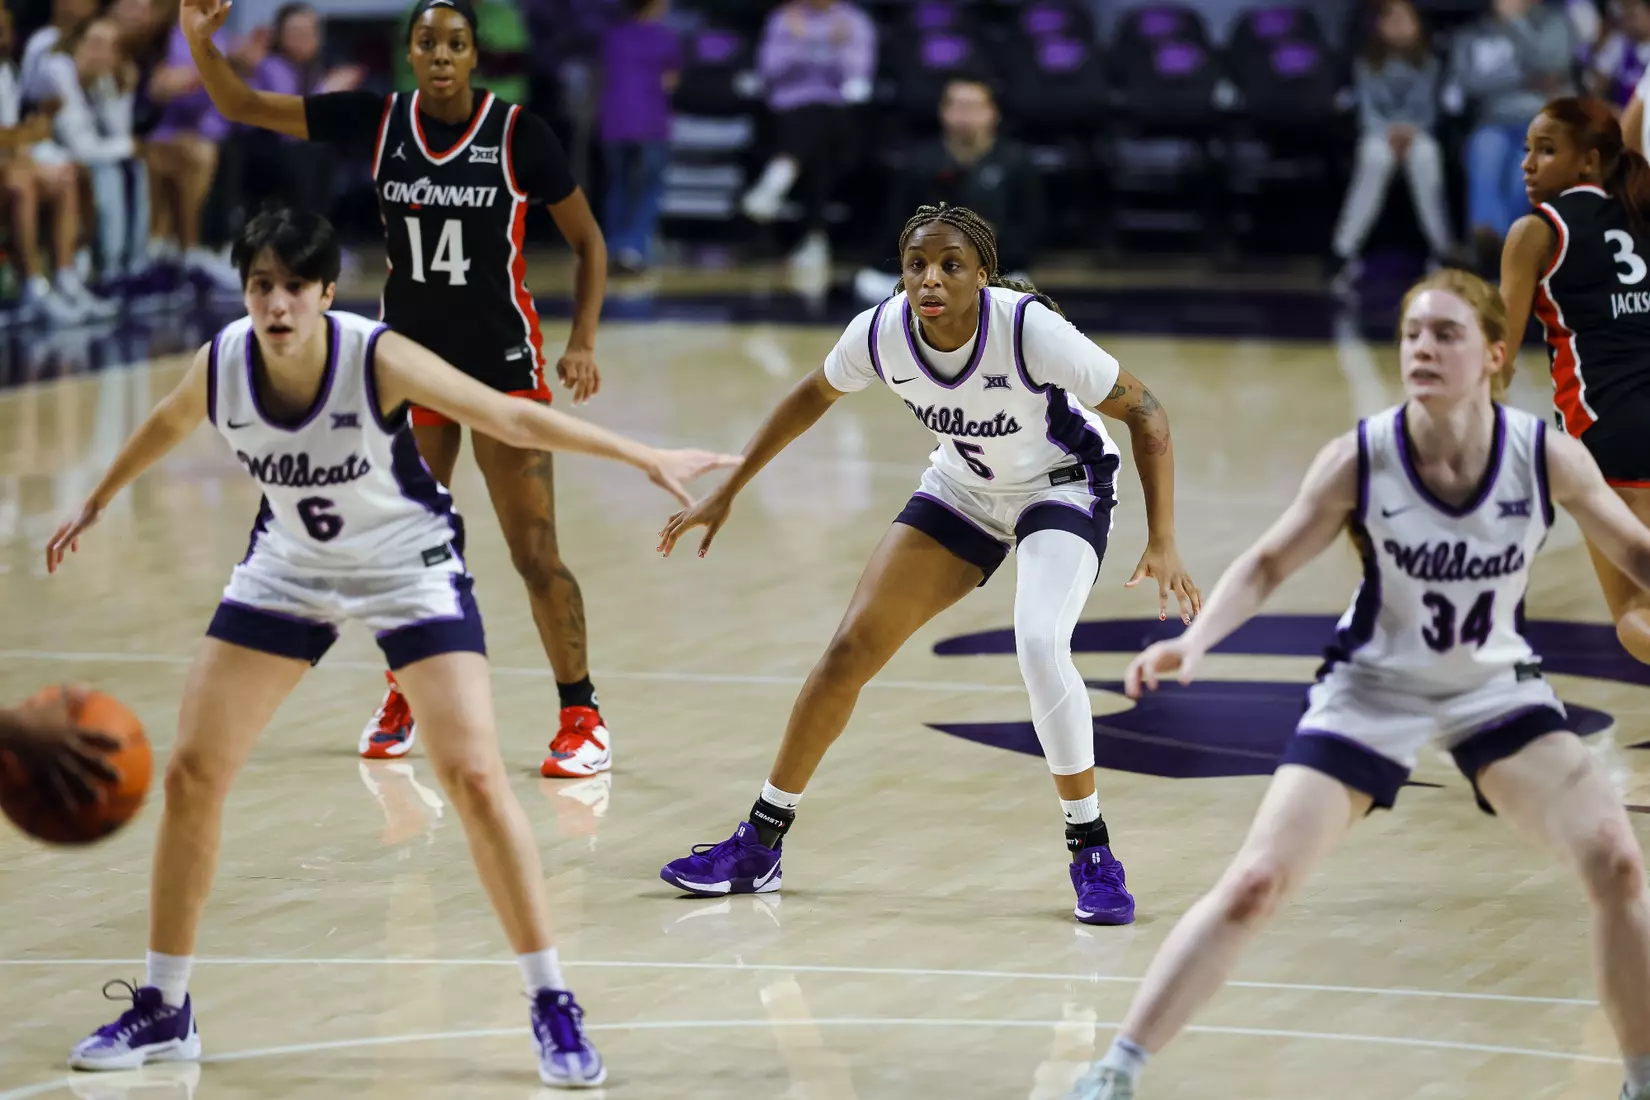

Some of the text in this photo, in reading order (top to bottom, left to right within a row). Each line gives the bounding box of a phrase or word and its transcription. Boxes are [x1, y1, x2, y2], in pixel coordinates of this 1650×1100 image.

[383, 176, 498, 208] CINCINNATI
[404, 216, 471, 286] 14
[1603, 228, 1647, 285] 3
[1611, 291, 1650, 319] JACKS
[904, 398, 1022, 438] Wildcats
[236, 449, 371, 487] Wildcats
[952, 438, 995, 481] 5
[296, 496, 345, 542] 6
[1383, 540, 1524, 582] Wildcats
[1422, 590, 1495, 653] 34
